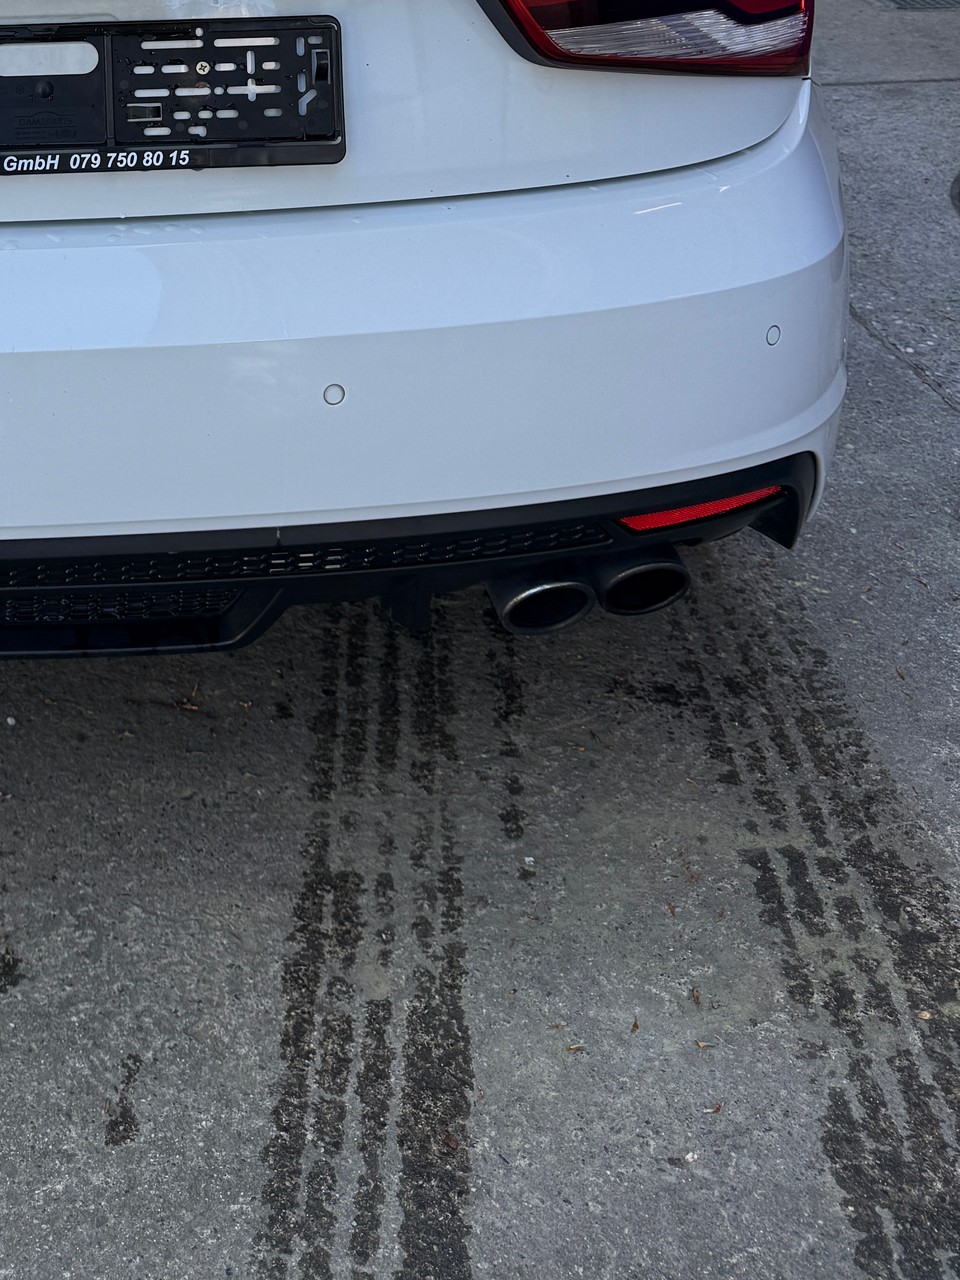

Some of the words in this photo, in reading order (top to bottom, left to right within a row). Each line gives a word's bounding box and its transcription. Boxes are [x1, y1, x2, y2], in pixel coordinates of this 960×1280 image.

[3, 154, 60, 171] GmbH
[69, 153, 101, 169] 079
[106, 151, 138, 168] 750
[142, 150, 164, 167] 80
[169, 150, 190, 166] 15
